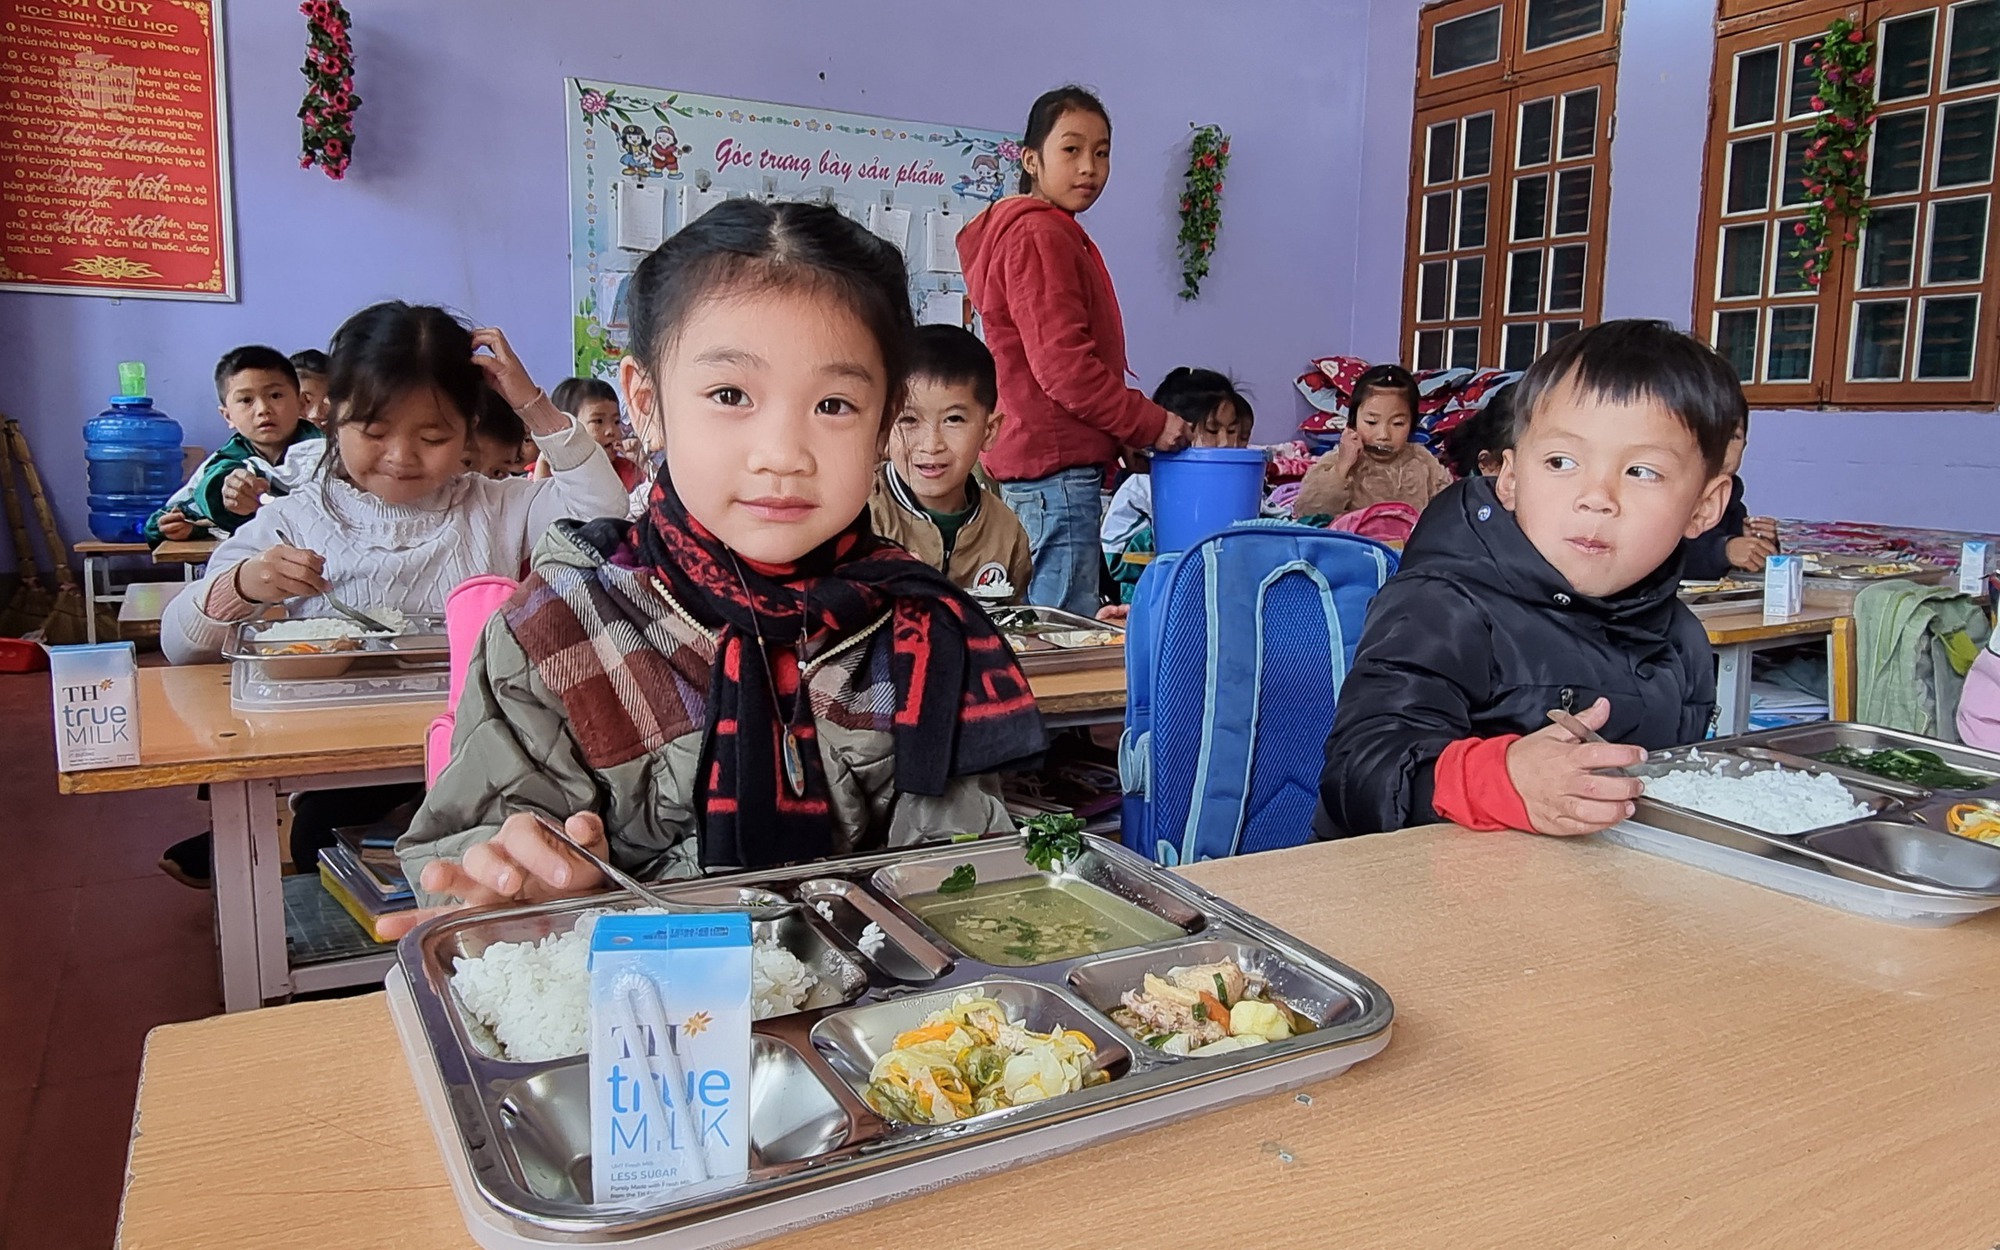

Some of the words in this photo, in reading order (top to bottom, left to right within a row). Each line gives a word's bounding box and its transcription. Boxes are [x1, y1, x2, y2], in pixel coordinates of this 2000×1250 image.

[15, 4, 52, 16] HỌC
[58, 10, 97, 22] SINH
[102, 14, 139, 28] TIỂU
[143, 21, 179, 33] HỌC
[40, 39, 59, 50] nhà
[60, 31, 70, 39] ra
[72, 31, 92, 41] vào
[94, 33, 111, 44] lớp
[112, 36, 138, 49] đúng
[140, 40, 157, 50] giờ
[158, 41, 180, 53] theo
[181, 46, 200, 57] quy
[148, 65, 162, 76] tài
[163, 68, 181, 79] sản
[182, 70, 202, 81] của
[163, 81, 181, 91] gia
[182, 83, 203, 93] các
[25, 91, 53, 105] Trang
[165, 107, 184, 117] phù
[184, 110, 204, 121] hợp
[56, 108, 77, 117] học
[156, 117, 185, 131] móng
[151, 129, 177, 142] trang
[22, 142, 43, 153] ảnh
[44, 144, 77, 157] hưởng
[78, 148, 99, 156] đến
[101, 150, 123, 160] chất
[125, 152, 153, 165] lượng
[154, 155, 174, 165] học
[175, 157, 192, 167] tập
[193, 159, 206, 169] và
[163, 144, 188, 155] đoàn
[190, 147, 206, 157] kết
[29, 155, 50, 165] của
[50, 157, 70, 166] nhà
[715, 138, 753, 173] Góc
[760, 149, 811, 181] trưng
[819, 150, 852, 183] bày
[858, 156, 891, 180] sản
[895, 159, 945, 188] phẩm
[173, 183, 193, 192] nhà
[194, 185, 208, 195] và
[68, 200, 88, 209] quy
[178, 195, 191, 204] và
[187, 221, 210, 234] tàng
[190, 232, 210, 242] các
[57, 236, 79, 246] độc
[104, 239, 129, 249] Cấm
[132, 240, 149, 249] hút
[185, 244, 210, 256] uống
[62, 685, 100, 703] TH
[62, 705, 127, 728] true
[66, 723, 129, 746] MILK
[611, 1109, 731, 1156] MLK
[611, 1171, 637, 1182] LESS
[640, 1167, 678, 1179] SUGAR
